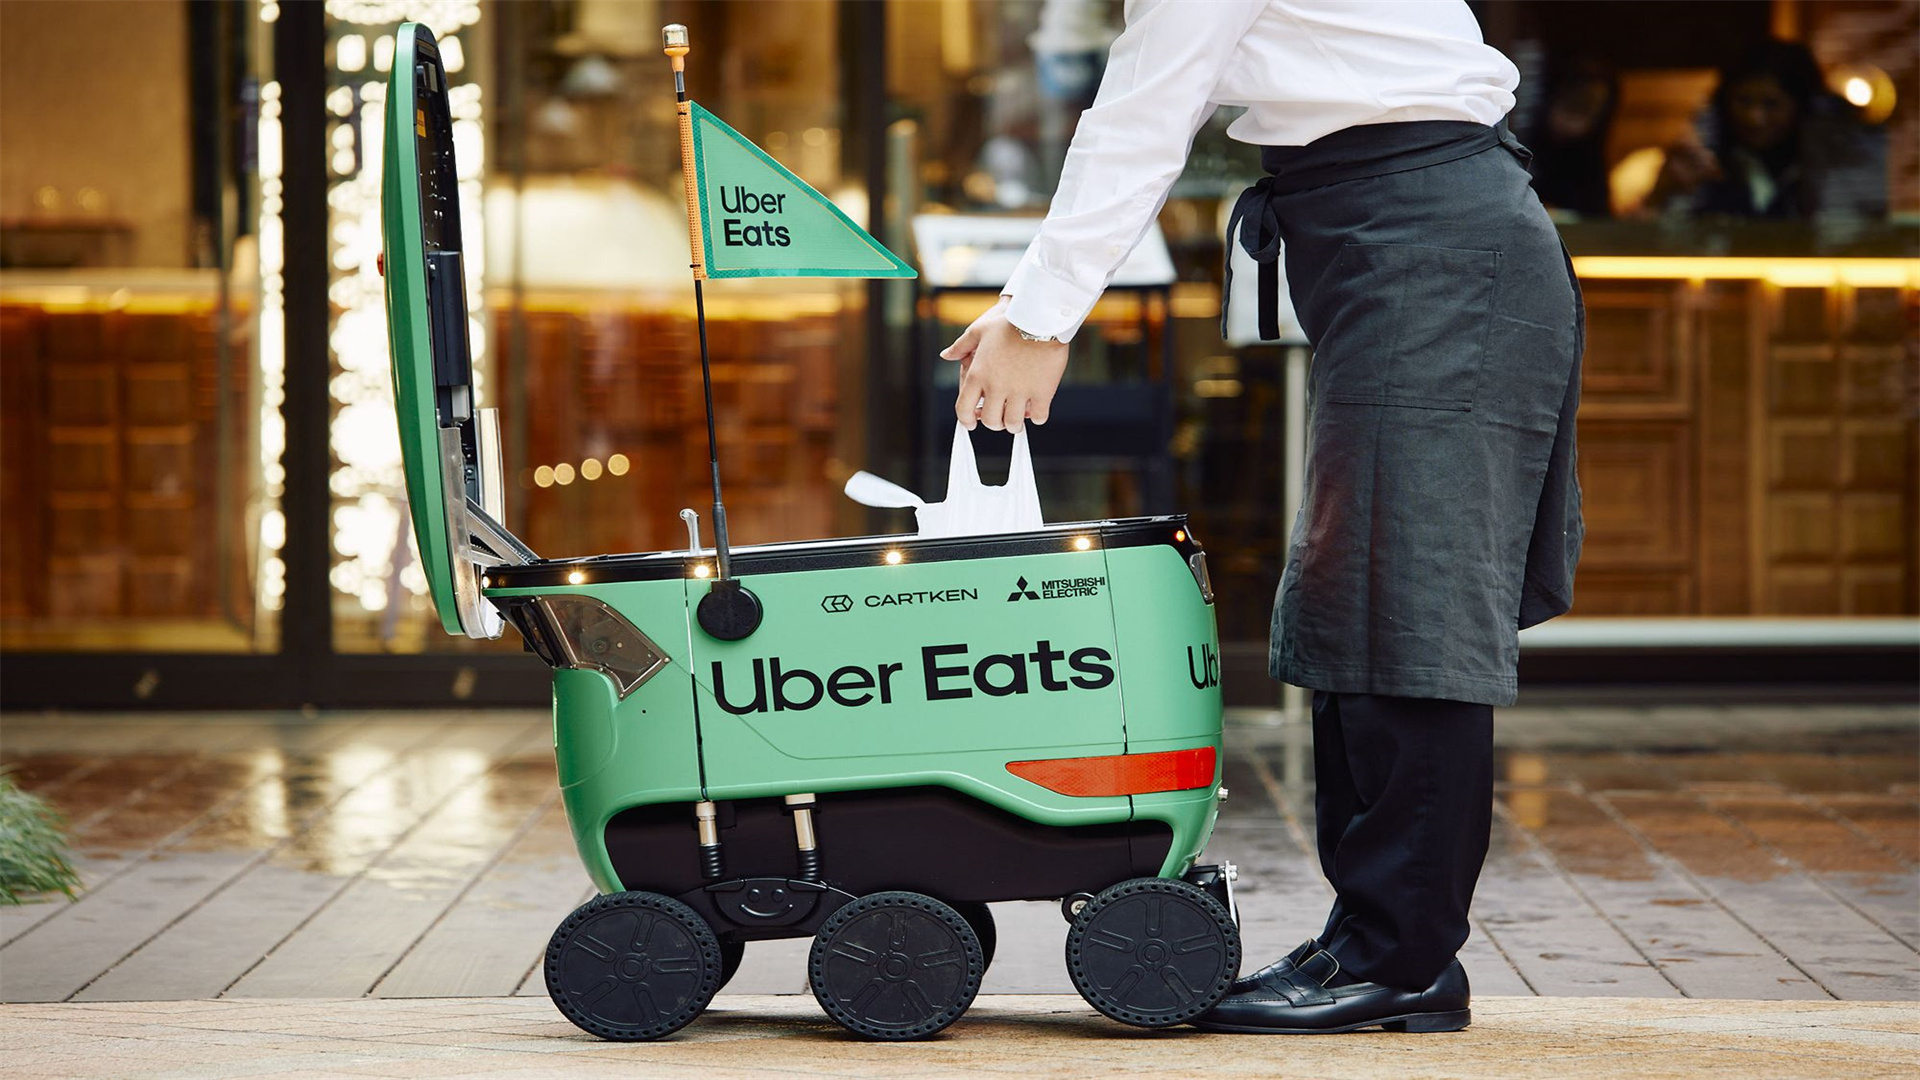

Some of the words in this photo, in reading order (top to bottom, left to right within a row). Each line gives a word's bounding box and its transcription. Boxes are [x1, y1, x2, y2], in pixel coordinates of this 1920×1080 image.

[720, 186, 786, 214] Uber
[723, 219, 791, 247] Eats
[1042, 577, 1105, 590] MITSUBISHI
[1043, 586, 1098, 599] ELECTRIC
[864, 588, 978, 608] CARTKEN
[711, 656, 903, 716] Uber
[921, 640, 1115, 701] Eats
